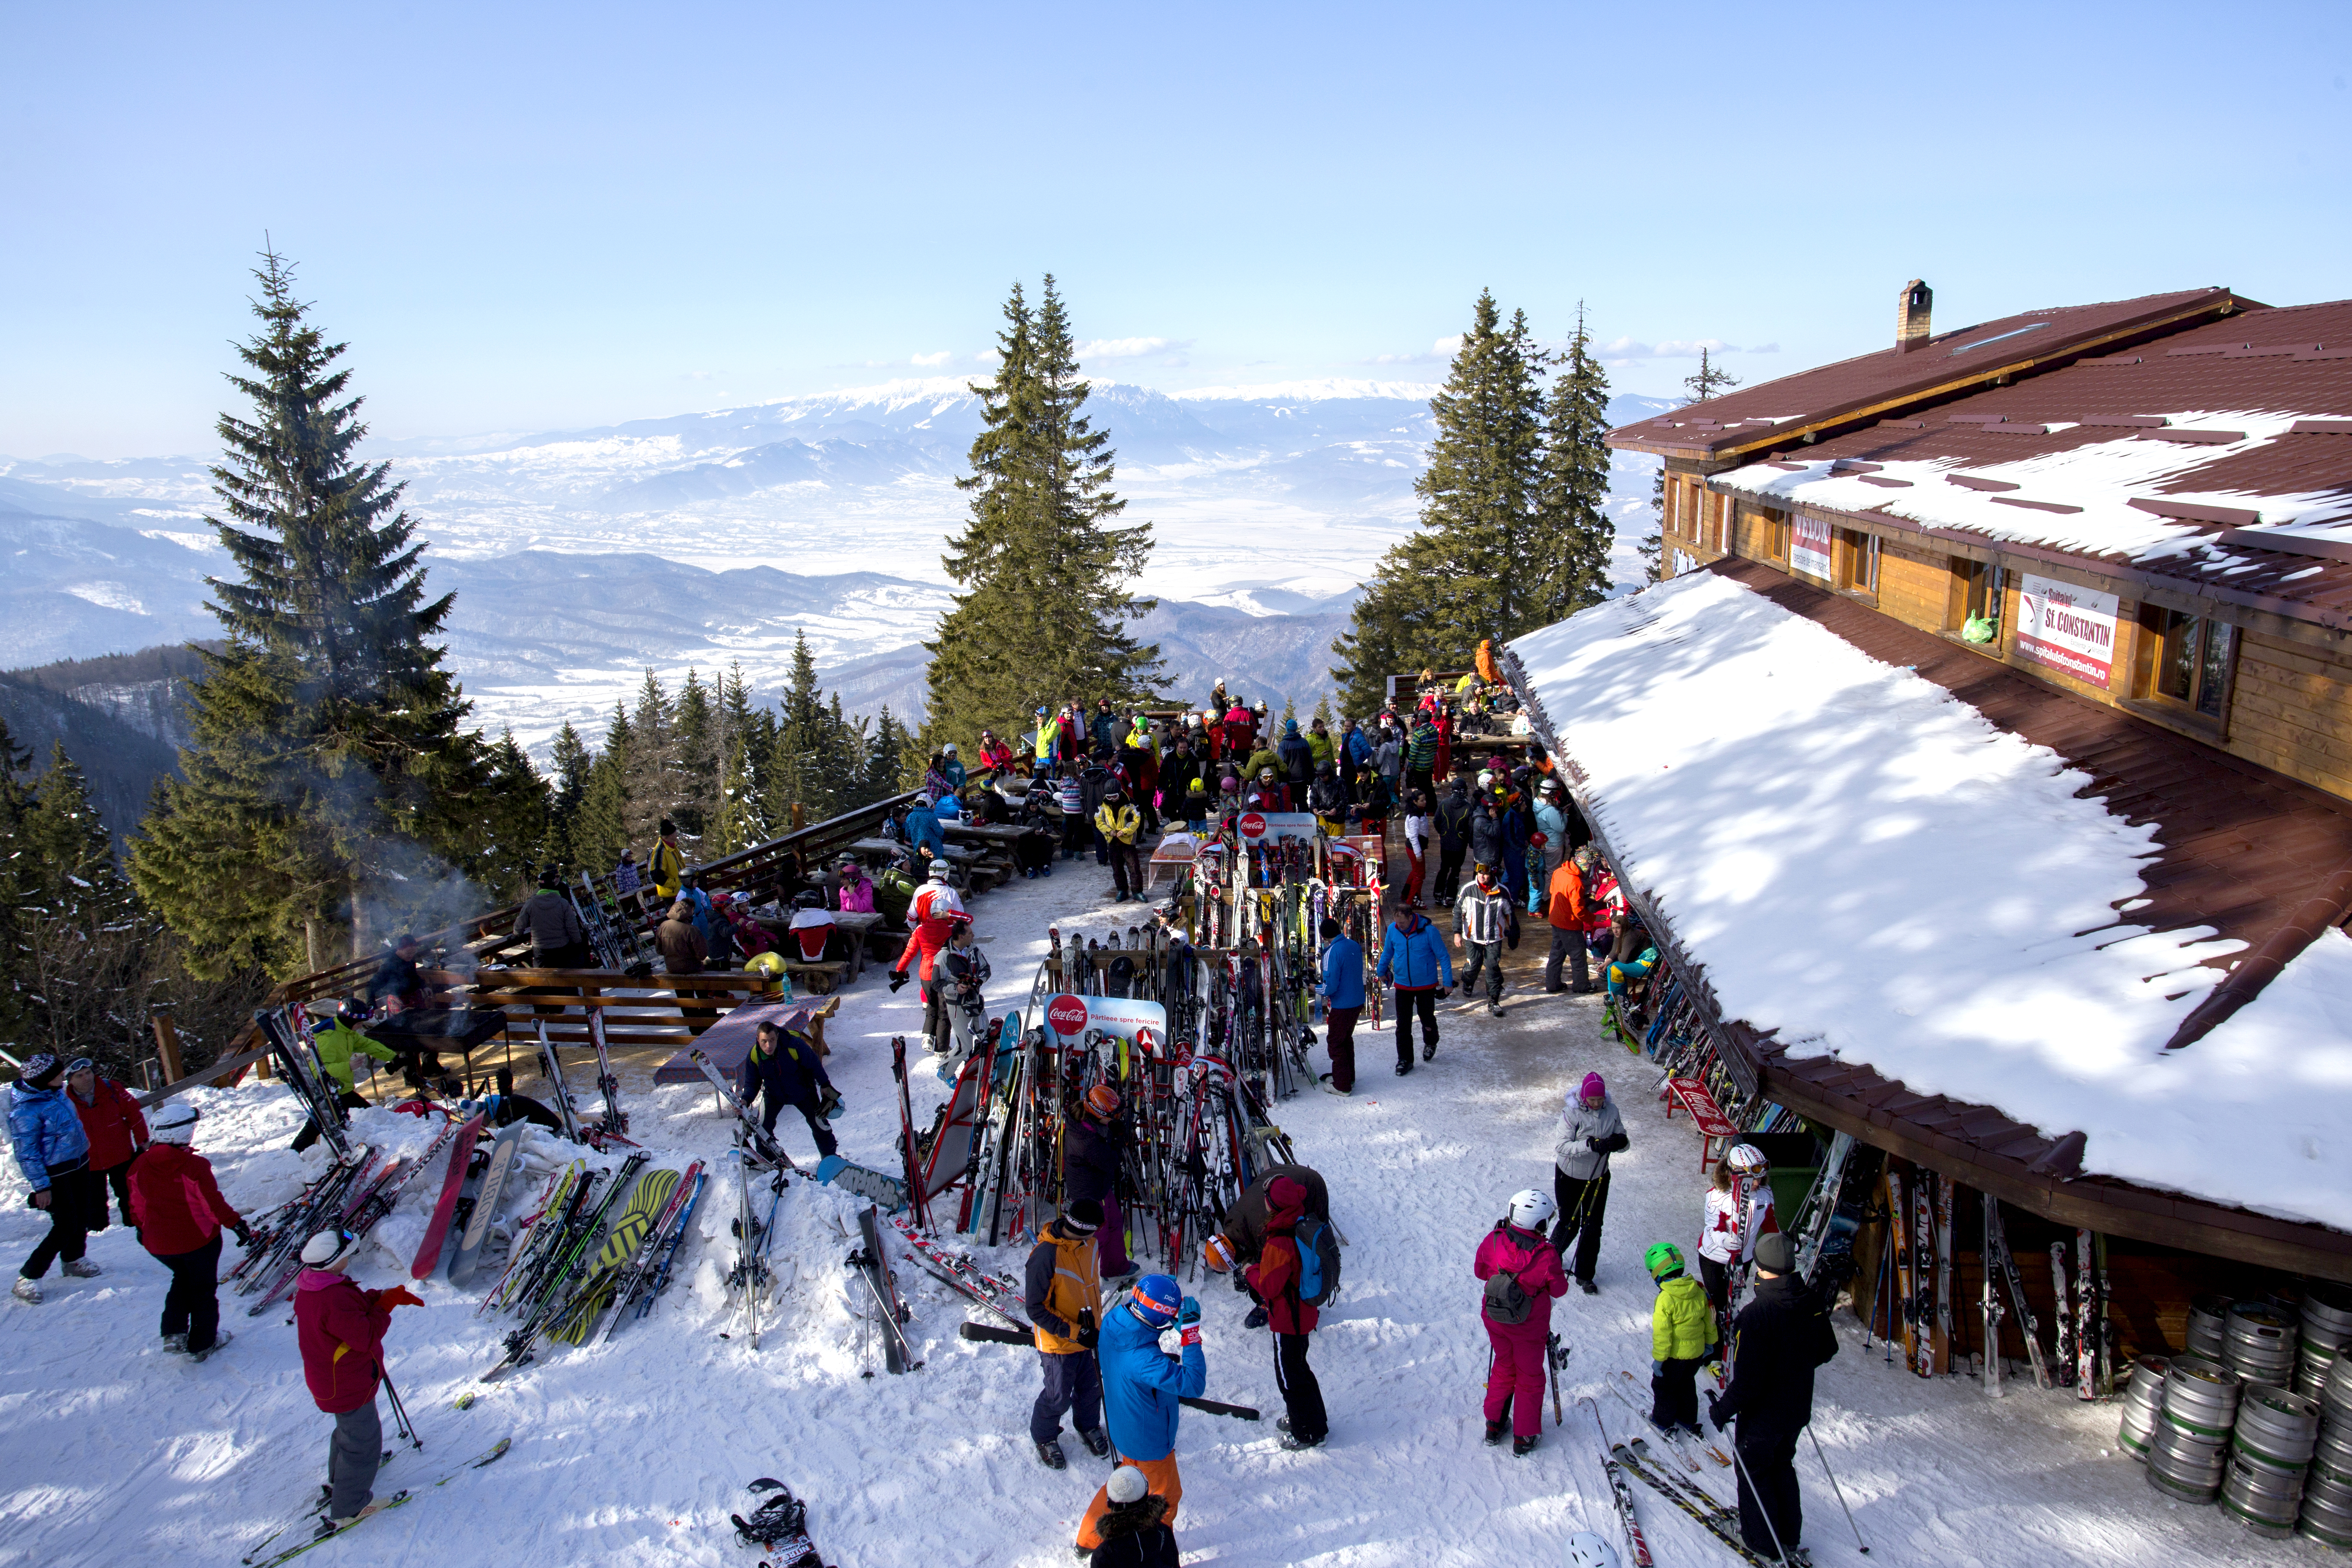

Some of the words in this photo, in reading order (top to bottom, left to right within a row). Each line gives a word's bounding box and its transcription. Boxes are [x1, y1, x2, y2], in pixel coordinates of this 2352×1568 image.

[1806, 556, 1810, 567] de
[2048, 588, 2073, 608] Spitalul
[2046, 608, 2055, 630] Sf.
[2057, 611, 2111, 647] CONSTANTIN
[2020, 639, 2106, 680] www.spitalulsfconstantin.ro
[1050, 1008, 1085, 1022] Coca-Cola
[1088, 1102, 1107, 1116] BRIKO
[1682, 1091, 1722, 1120] Coca-Cola
[410, 1130, 456, 1180] ATOMIC
[471, 1157, 507, 1233] NOBILE
[547, 1175, 570, 1214] FISCHER
[1067, 1216, 1096, 1229] BRIKO
[1739, 1182, 1751, 1243] ATOMIC
[1227, 1259, 1237, 1269] uvex
